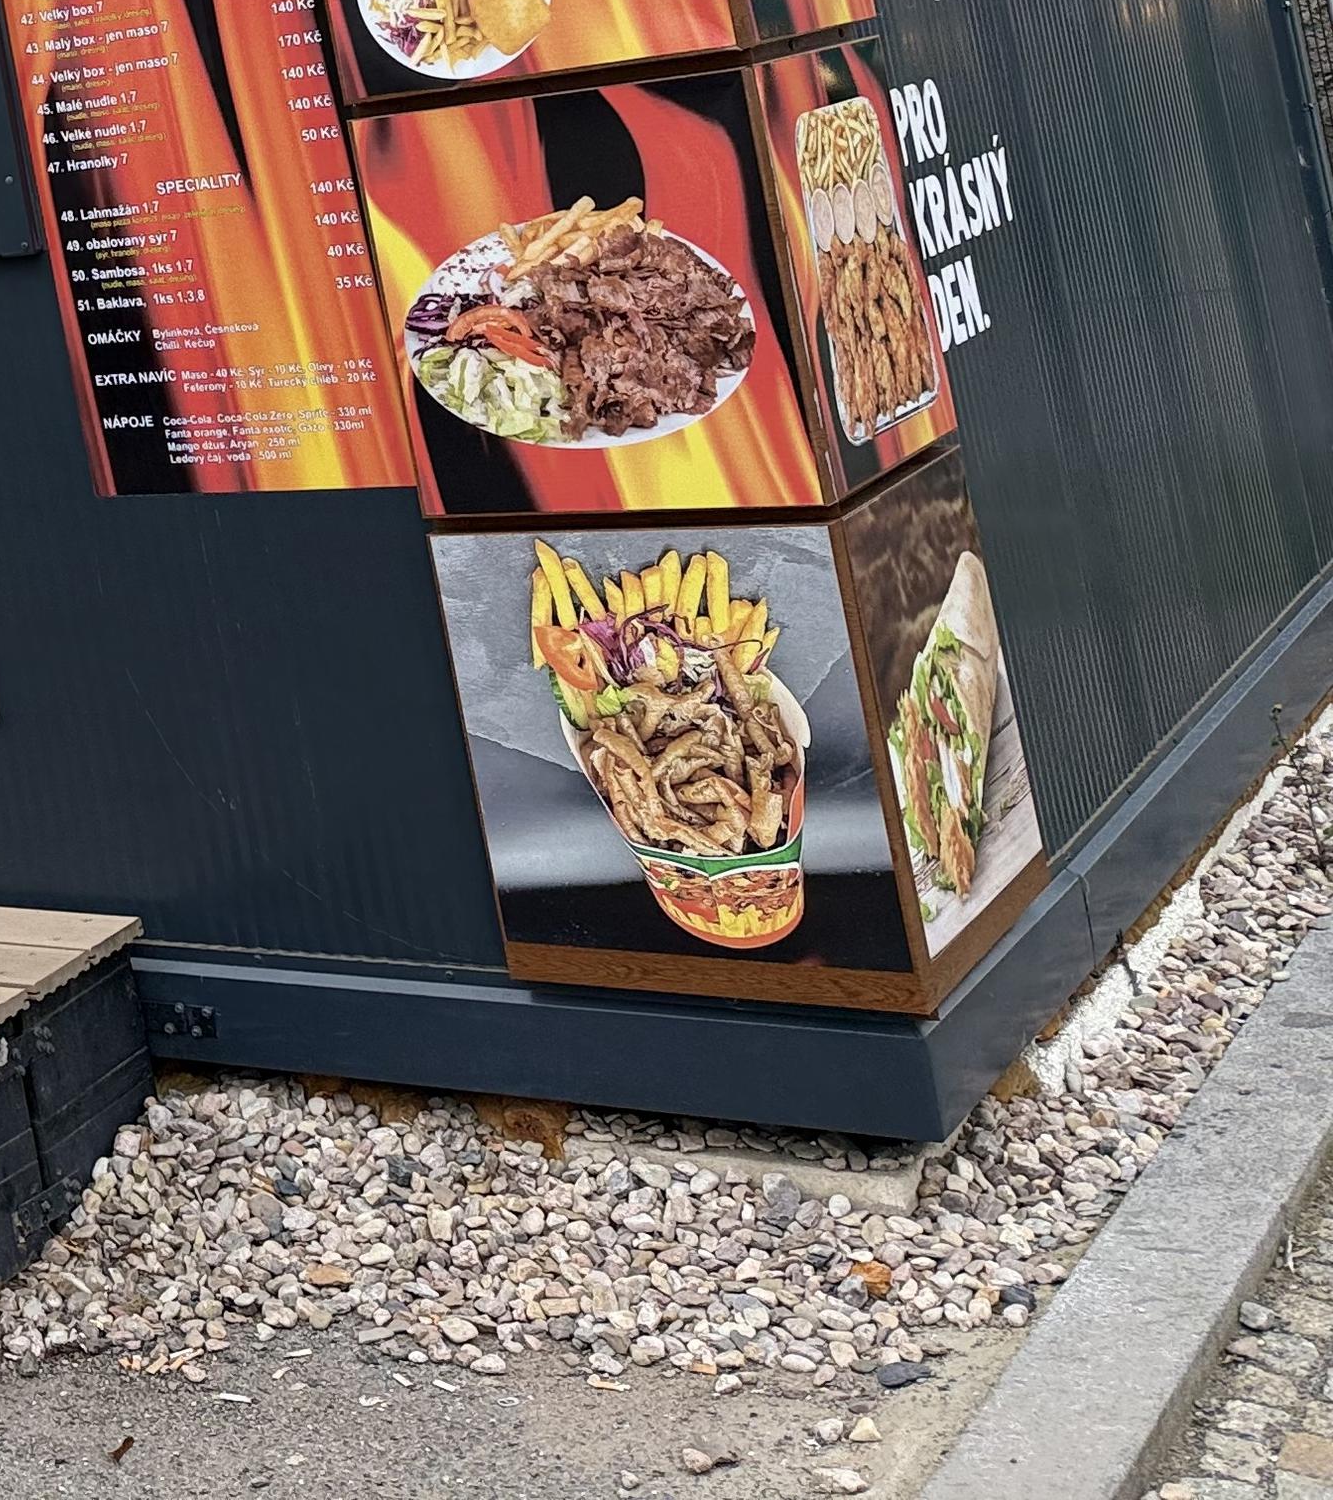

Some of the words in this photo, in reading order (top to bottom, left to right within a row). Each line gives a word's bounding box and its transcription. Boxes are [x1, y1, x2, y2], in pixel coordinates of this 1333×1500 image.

[270, 0, 294, 14] 140
[277, 32, 301, 47] 170
[302, 29, 322, 44] Kč
[281, 65, 304, 79] 140
[305, 62, 325, 77] Kč
[84, 94, 118, 109] nudle
[287, 96, 311, 111] 140
[312, 93, 332, 108] Kč
[93, 123, 127, 138] nudle
[889, 78, 947, 167] PRO
[301, 127, 318, 142] 50
[319, 125, 339, 139] Kč
[65, 155, 118, 171] Hranolky
[119, 152, 128, 165] 7
[155, 172, 241, 195] SPECIALITY
[309, 180, 333, 194] 140
[335, 177, 355, 192] Kč
[909, 134, 1013, 260] KRÁSNÝ
[79, 203, 140, 221] Lahmažán
[314, 212, 338, 226] 140
[339, 209, 359, 224] Kč
[147, 232, 168, 246] sýr
[169, 228, 177, 242] 7
[326, 243, 343, 257] 40
[344, 242, 365, 256] Kč
[151, 261, 173, 274] 1ks
[334, 275, 352, 289] 35
[353, 274, 373, 287] Kč
[152, 292, 174, 305] 1ks
[927, 254, 992, 353] DEN.
[87, 328, 141, 345] OMÁČKY
[94, 372, 137, 387] EXTRA
[137, 367, 177, 383] NAVÍC
[102, 414, 154, 429] NÁPOJE
